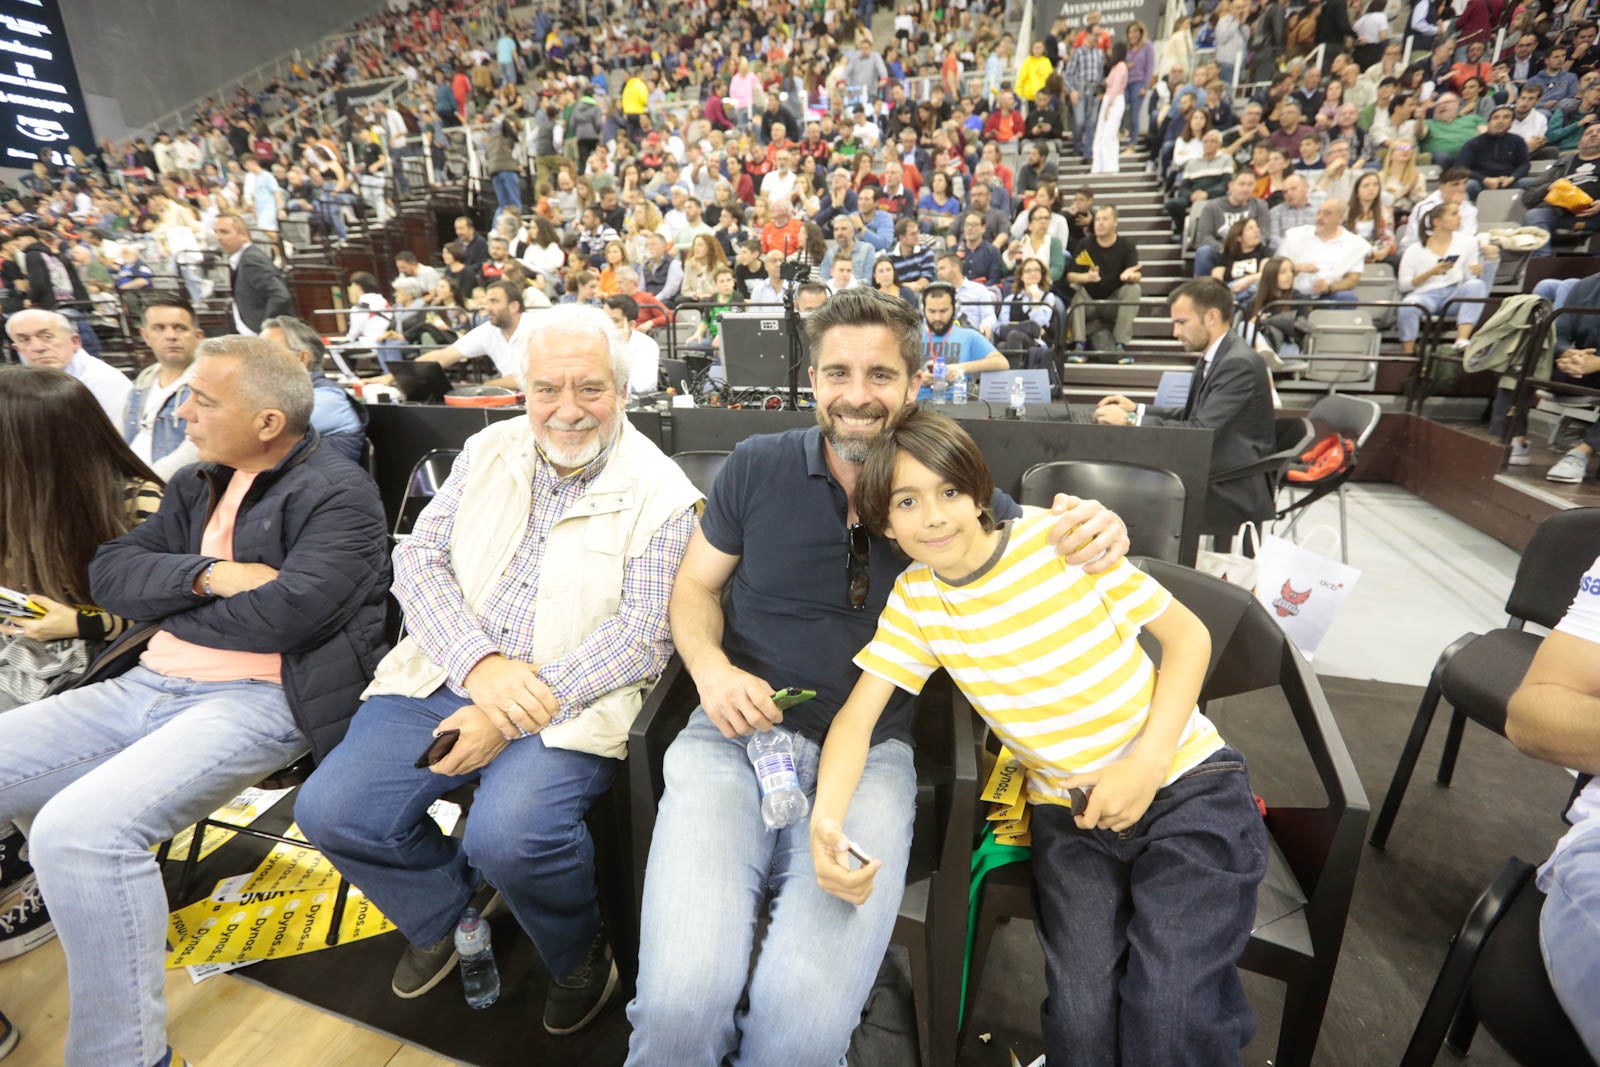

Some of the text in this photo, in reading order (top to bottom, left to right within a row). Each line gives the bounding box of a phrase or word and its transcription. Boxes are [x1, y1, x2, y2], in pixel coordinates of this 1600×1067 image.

[1082, 11, 1136, 27] GANADA
[993, 766, 1018, 800] Dynos.es
[247, 852, 285, 890] Dynos.es
[295, 854, 323, 888] ynos.es
[267, 911, 295, 957] Dynos.es
[296, 904, 321, 951] Dynos.es
[353, 897, 369, 938] ynos.es
[174, 928, 210, 965] Dynos.es
[206, 923, 239, 961] Dynos.es
[237, 917, 268, 960] Dynos.es
